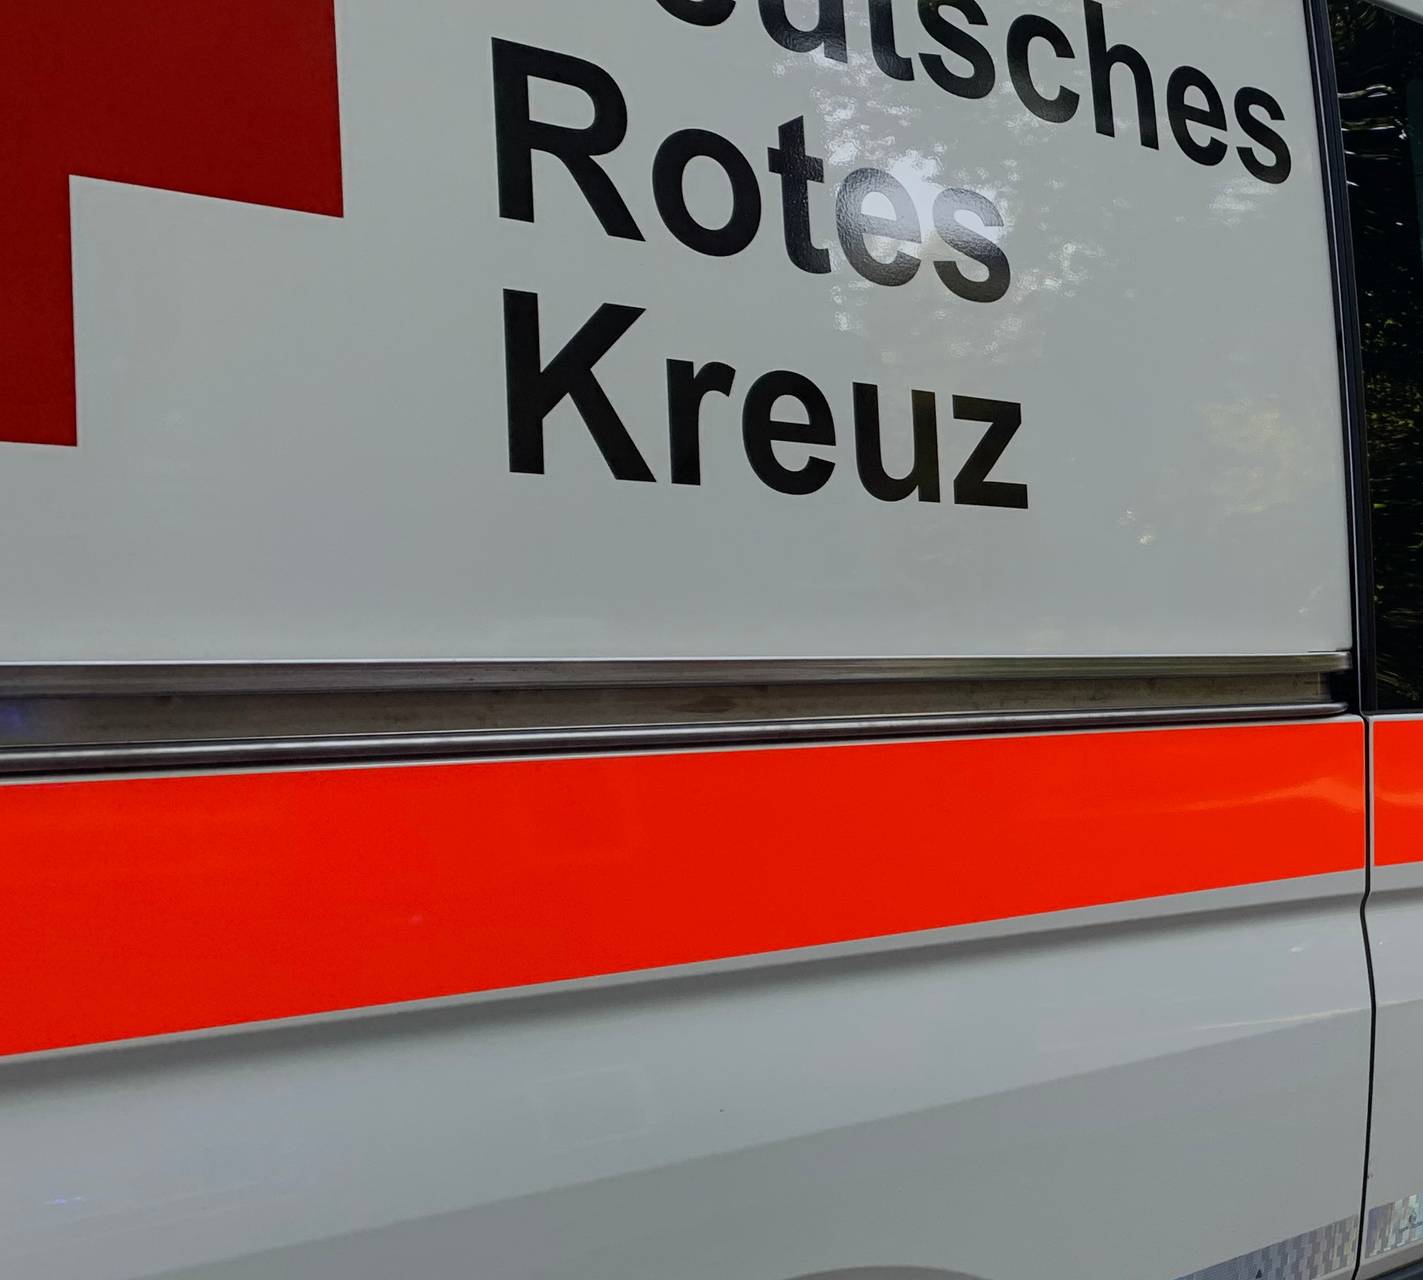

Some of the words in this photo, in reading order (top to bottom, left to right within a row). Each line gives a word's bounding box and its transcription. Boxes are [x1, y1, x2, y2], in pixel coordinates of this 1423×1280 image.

[491, 37, 1011, 304] Rotes
[653, 0, 1293, 185] utsches
[503, 288, 1029, 509] Kreuz
